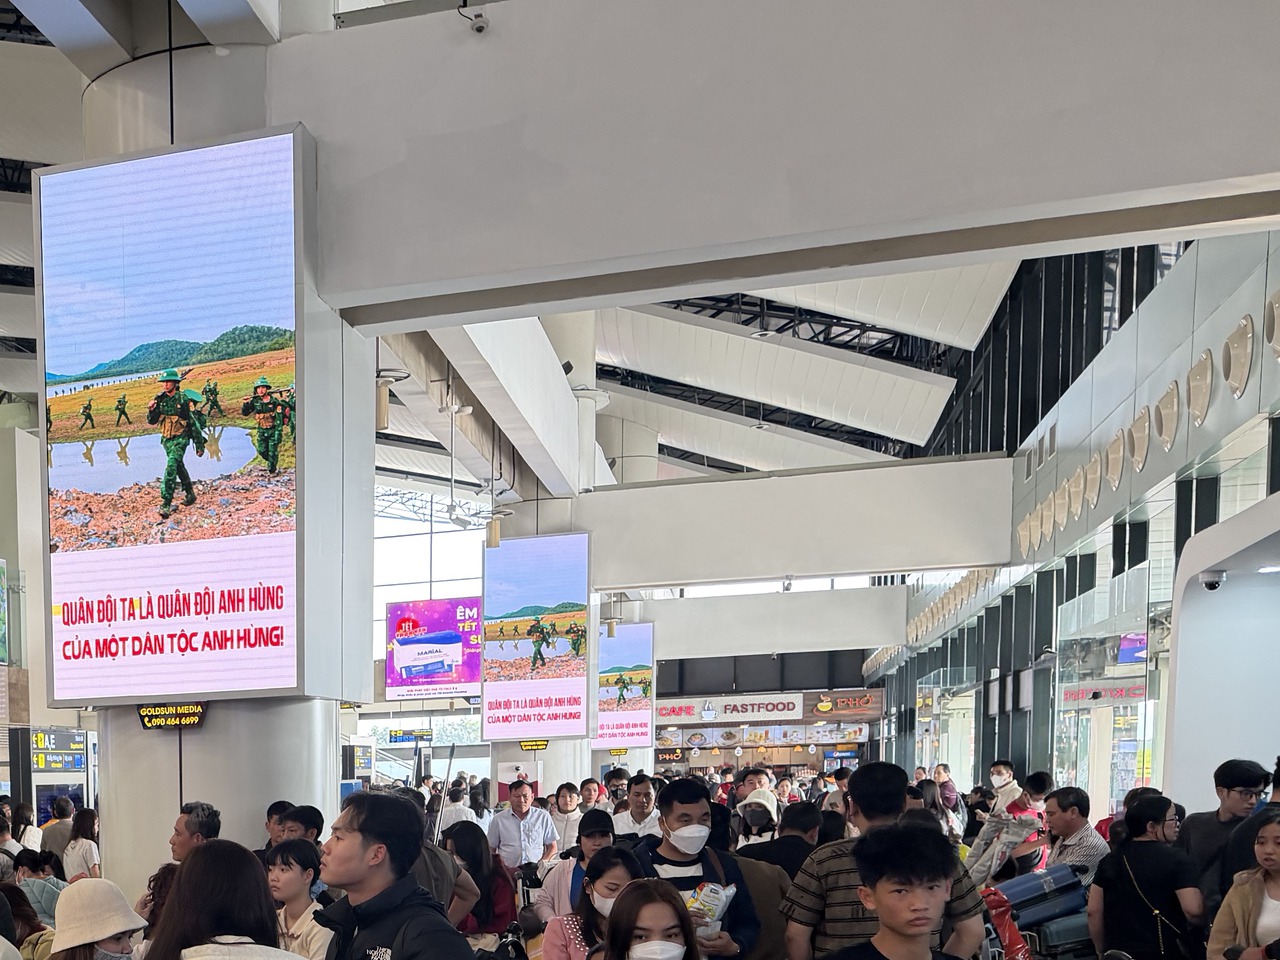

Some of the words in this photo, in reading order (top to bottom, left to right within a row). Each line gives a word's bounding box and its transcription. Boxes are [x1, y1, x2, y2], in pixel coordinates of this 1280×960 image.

[62, 596, 94, 627] QUÂN
[97, 594, 117, 628] ĐỘI
[120, 597, 135, 621] TA
[139, 591, 154, 620] LÀ
[157, 589, 191, 619] QUÂN
[194, 586, 215, 620] ĐỘI
[218, 588, 245, 614] ANH
[248, 582, 284, 611] HÙNG
[456, 605, 478, 620] ÊM
[457, 620, 477, 632] TẾT
[62, 635, 92, 660] CỦA
[95, 633, 129, 660] MỘT
[131, 631, 165, 656] DÂN
[167, 629, 198, 656] TỘC
[201, 630, 234, 651] ANH
[236, 624, 284, 649] HÙNG!
[488, 699, 502, 711] QUÂN
[513, 699, 520, 709] TA
[521, 697, 527, 709] LÀ
[529, 697, 543, 709] QUÂN
[554, 697, 566, 707] ANH
[566, 695, 581, 706] HÙNG
[723, 701, 796, 714] FASTFOOD
[140, 706, 175, 715] GOLDSUN
[177, 705, 202, 714] MEDIA
[659, 705, 695, 717] CAFE
[151, 717, 165, 726] 090
[166, 717, 180, 725] 464
[181, 716, 199, 724] 6699
[487, 714, 501, 724] CỦA
[502, 713, 516, 724] MỘT
[532, 712, 546, 722] TỘC
[547, 713, 560, 721] ANH
